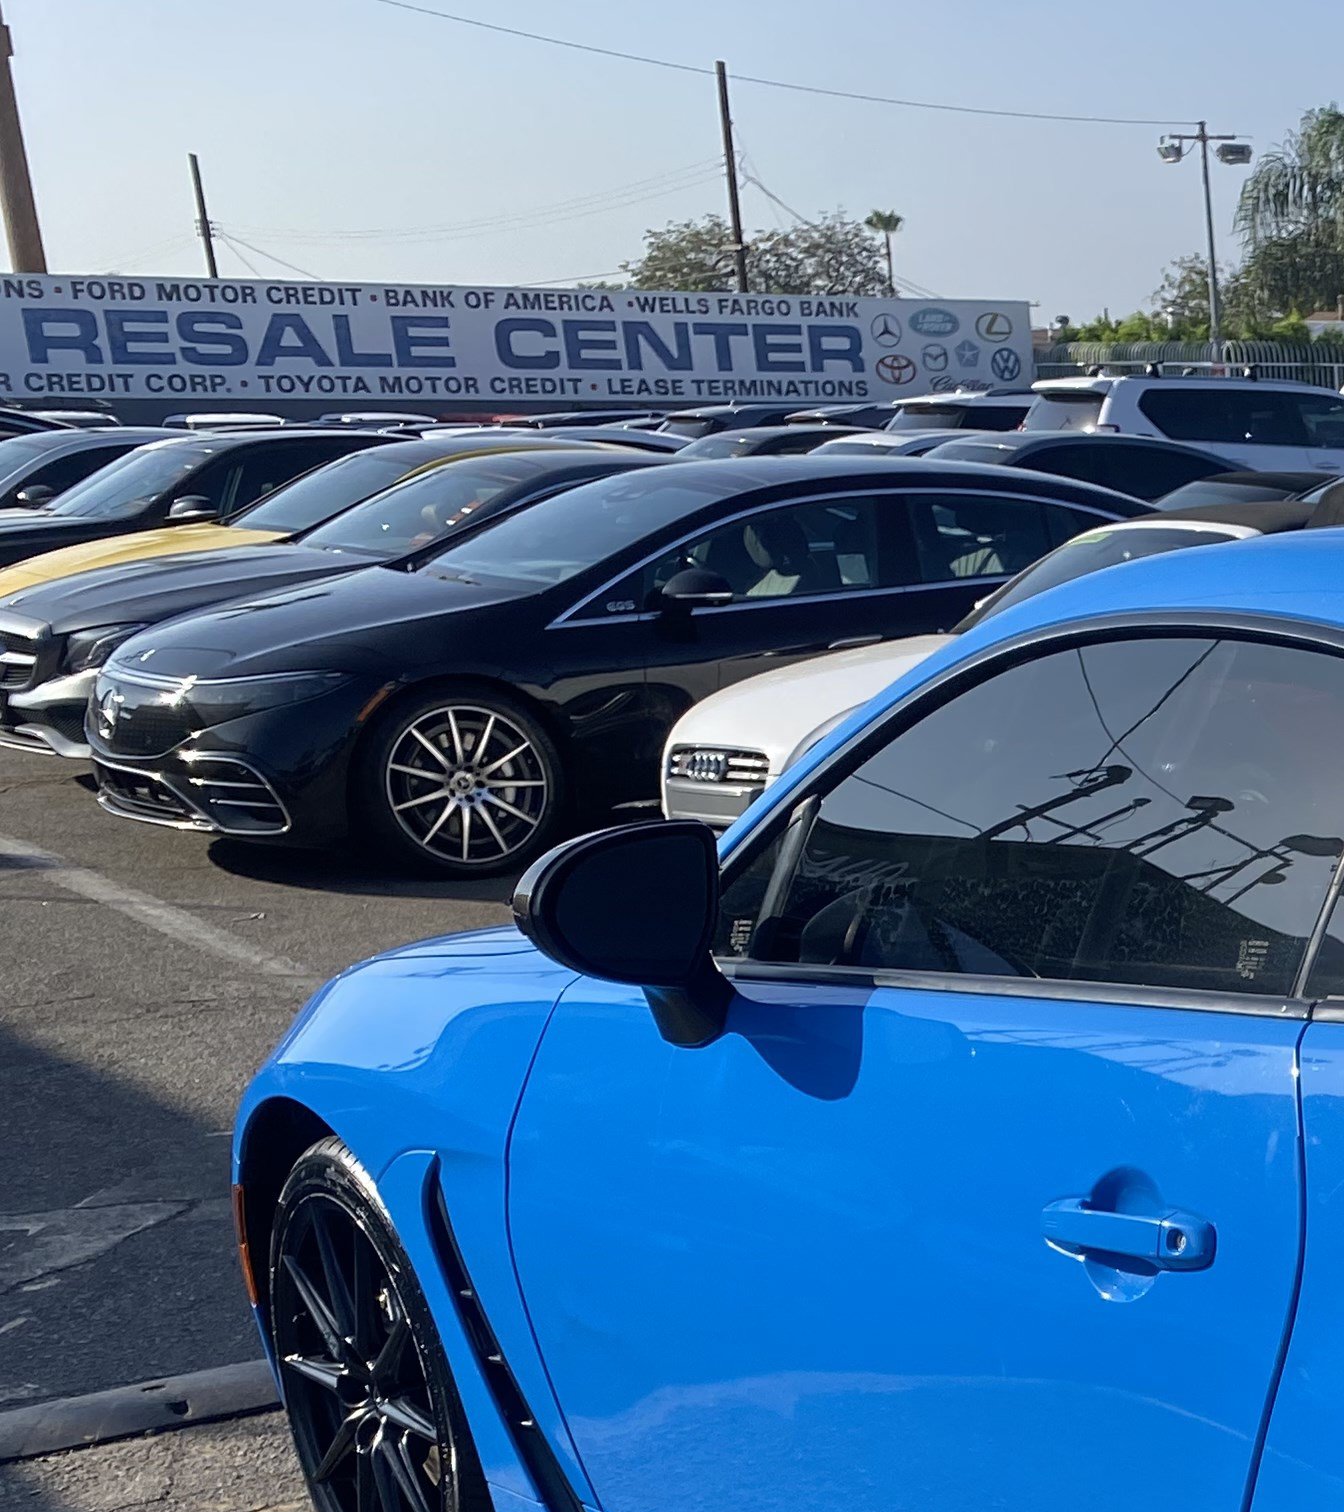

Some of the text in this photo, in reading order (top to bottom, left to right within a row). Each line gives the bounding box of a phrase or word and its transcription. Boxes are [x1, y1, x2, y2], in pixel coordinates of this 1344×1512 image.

[0, 279, 44, 299] NS
[70, 280, 362, 307] FORD MOTOR CREDIT
[384, 288, 615, 313] BANK OF AMERICA
[635, 295, 859, 319] WELLS FARGO BANK
[21, 308, 866, 373] RESALE CENTER
[23, 372, 134, 393] CREDIT
[145, 373, 232, 394] CORP.
[257, 374, 582, 395] TOYOTA MOTOR CREDIT
[607, 377, 868, 398] LEASE TERMINATIONS
